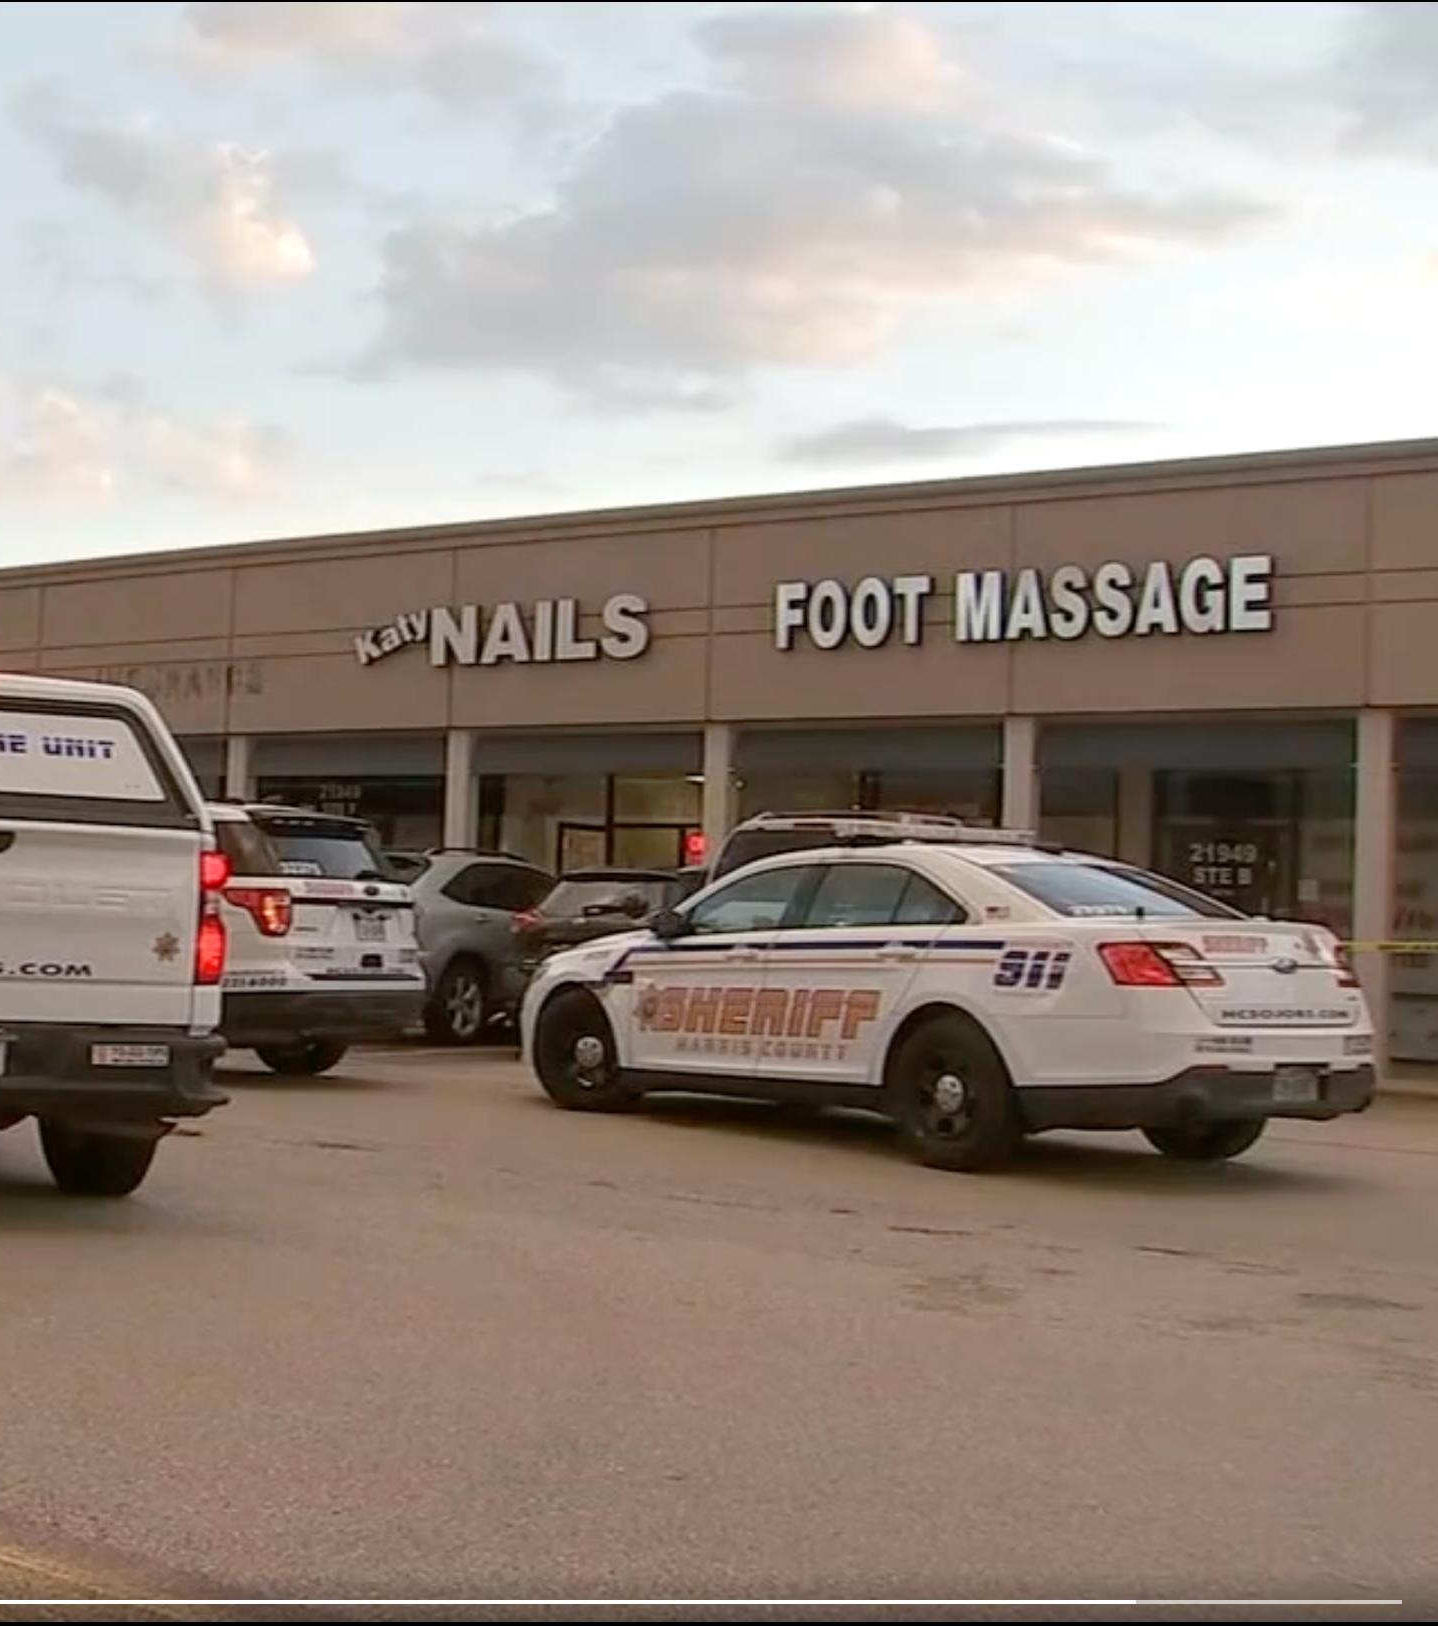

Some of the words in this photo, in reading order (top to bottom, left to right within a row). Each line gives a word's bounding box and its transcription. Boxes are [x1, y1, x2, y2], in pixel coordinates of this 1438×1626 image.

[775, 575, 932, 650] FOOT
[954, 555, 1273, 642] MASSAGE
[353, 608, 429, 666] Katy
[429, 593, 650, 667] NAILS
[43, 736, 116, 759] UNIT
[1189, 843, 1258, 864] 21949
[1193, 868, 1232, 885] STE
[993, 950, 1072, 990] 911
[649, 986, 883, 1039] SHERIFF
[675, 1037, 754, 1056] HARRIS
[761, 1041, 848, 1062] COUNTY
